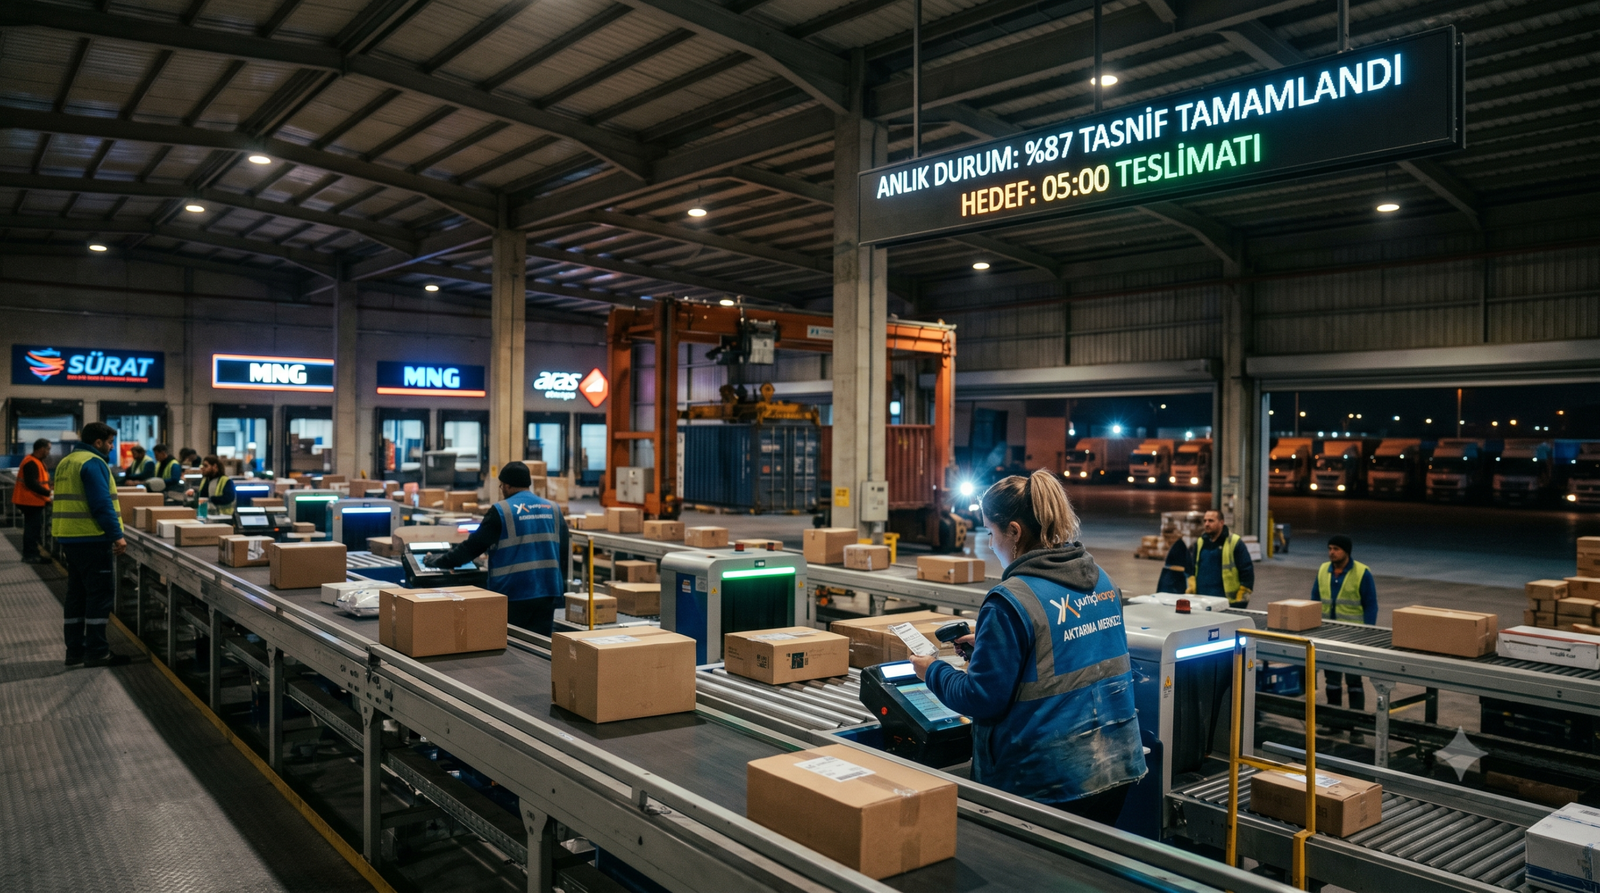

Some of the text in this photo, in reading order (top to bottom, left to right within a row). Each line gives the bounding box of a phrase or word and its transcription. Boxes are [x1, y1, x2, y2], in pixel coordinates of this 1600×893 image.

[877, 53, 1402, 199] ANLIK DURUM: %87 TASNİF TAMAMLANDI
[961, 133, 1261, 217] HEDEF: 05:00 TESLİMATI
[67, 351, 155, 377] SÜRAT
[249, 362, 308, 385] MNG
[403, 366, 460, 389] MNG
[533, 371, 583, 391] aras
[1063, 621, 1098, 642] AKTARMA
